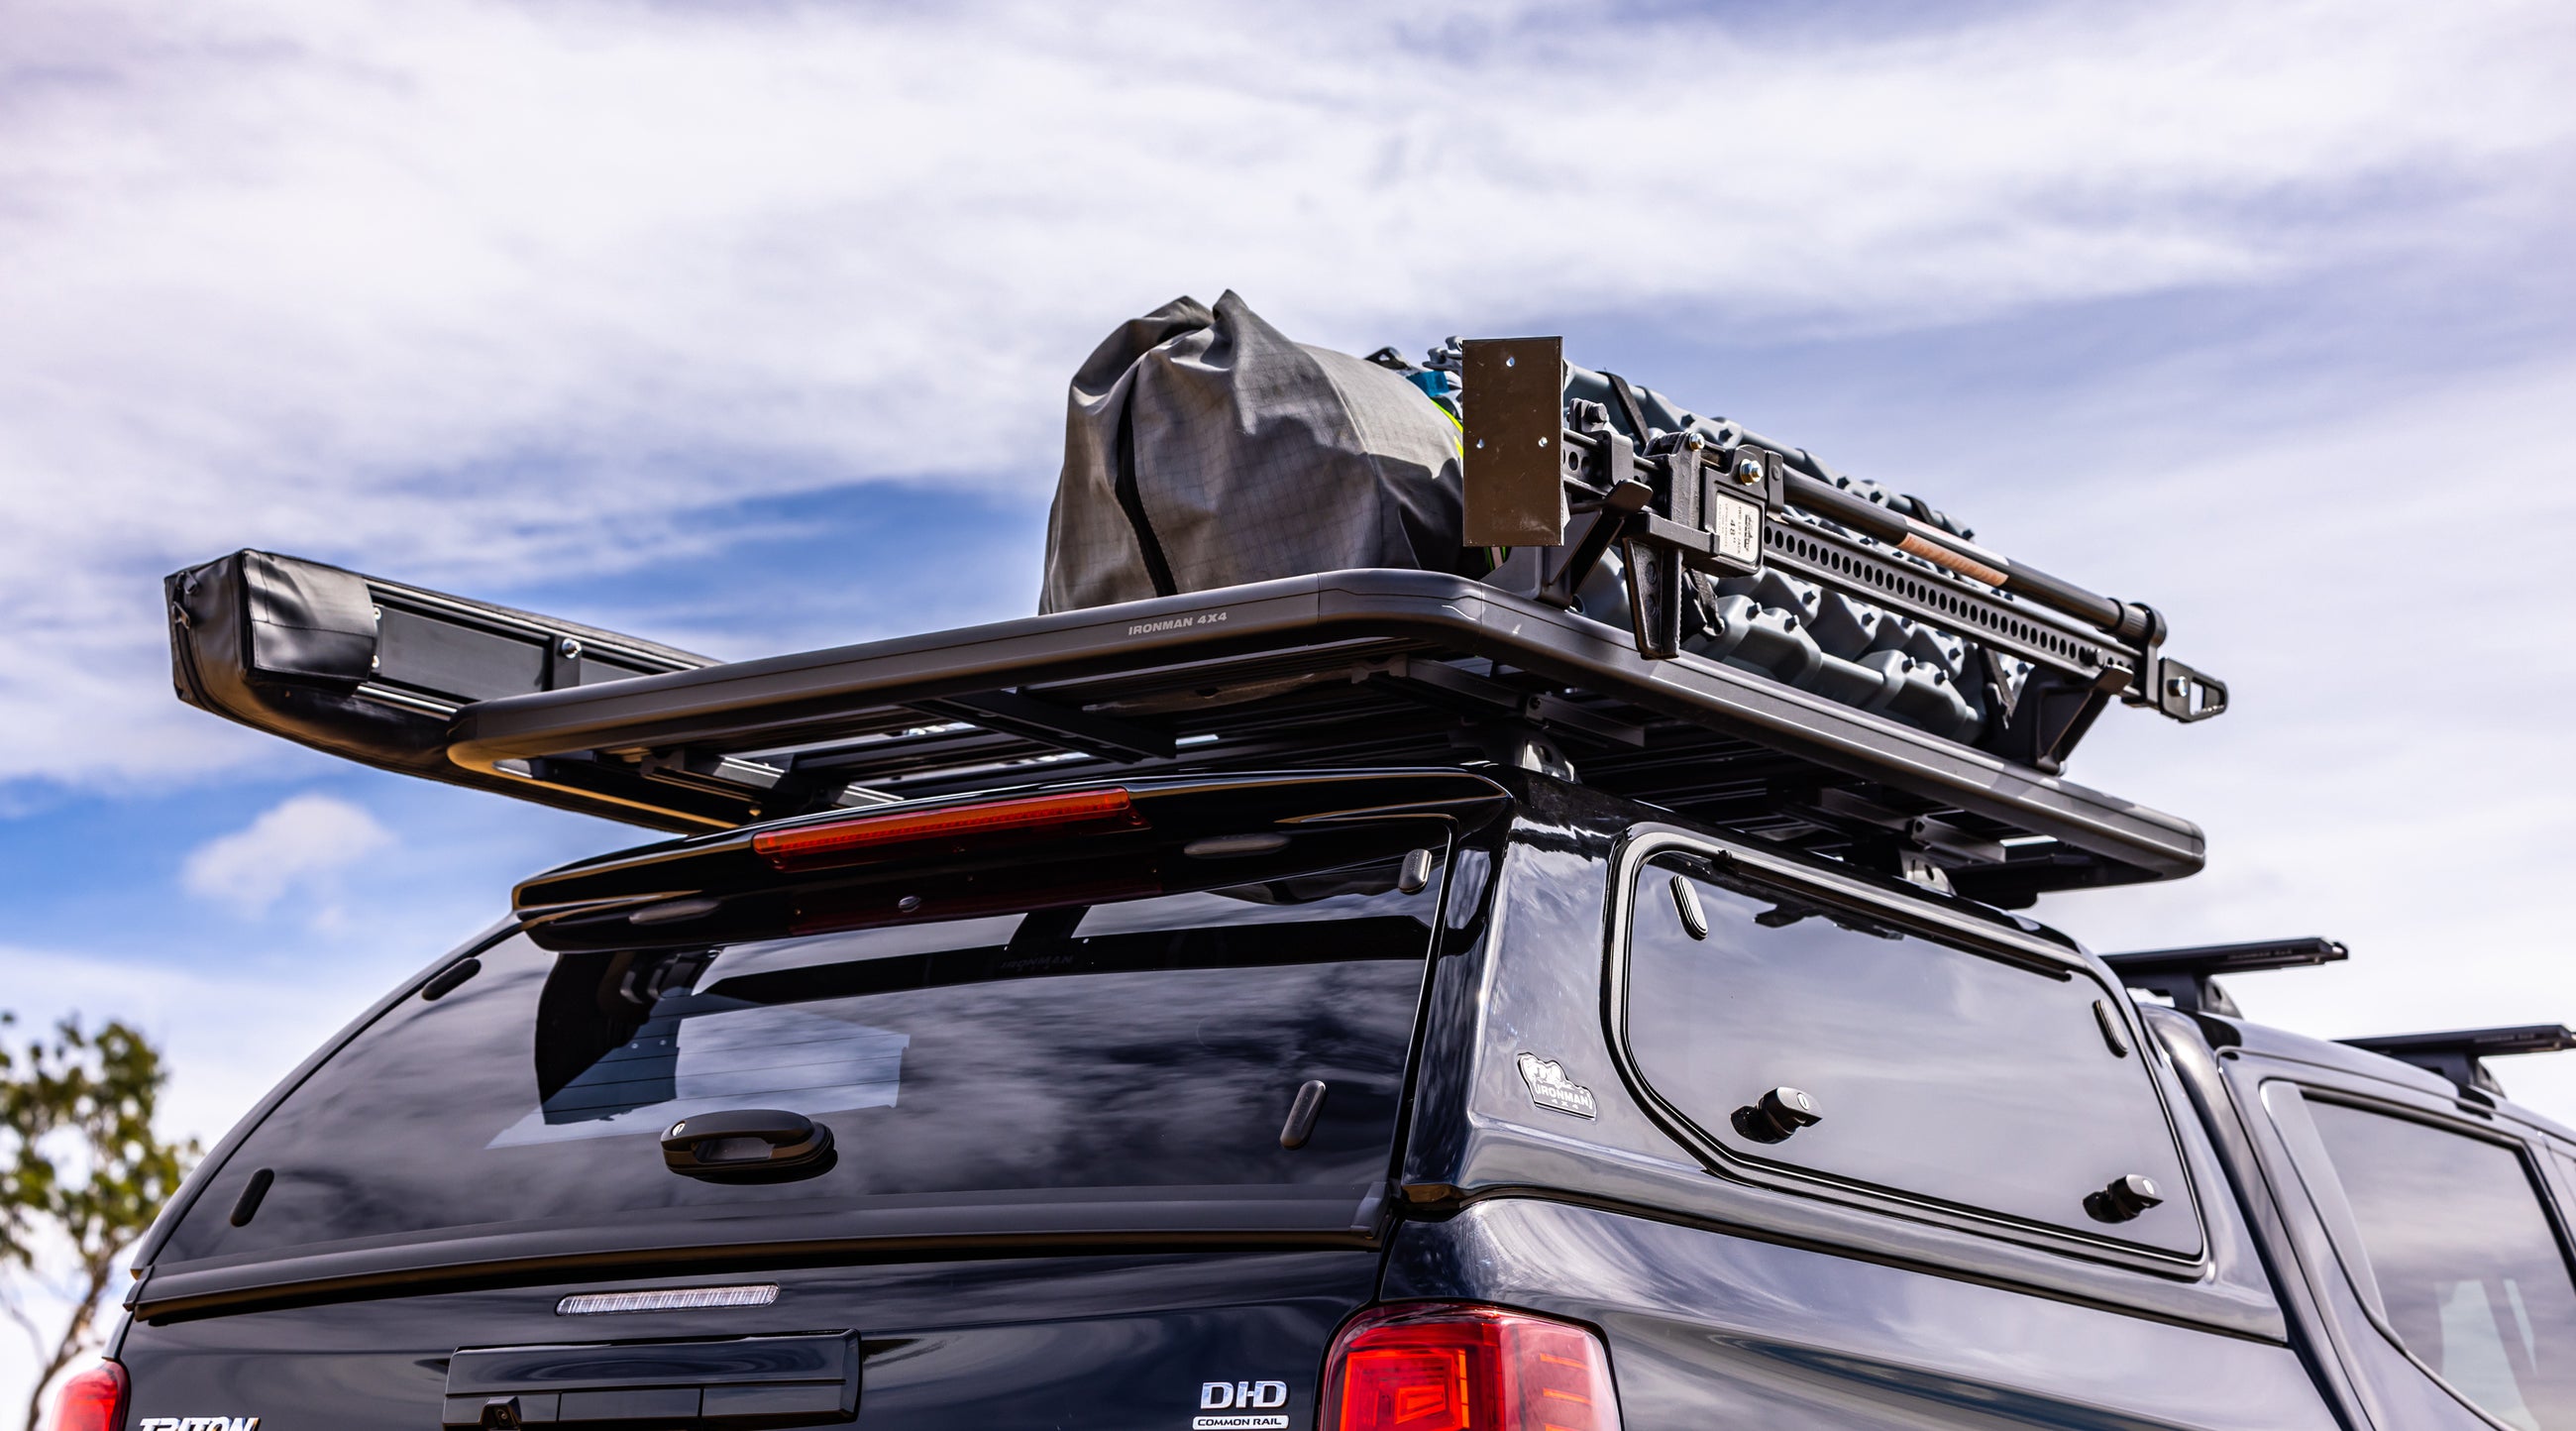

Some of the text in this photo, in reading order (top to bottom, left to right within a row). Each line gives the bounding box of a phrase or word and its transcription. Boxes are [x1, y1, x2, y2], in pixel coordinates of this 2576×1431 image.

[1127, 611, 1228, 636] IRONMAN 4X4
[1535, 1084, 1590, 1107] IRONMAN
[1197, 1417, 1282, 1427] COMMON RAIL
